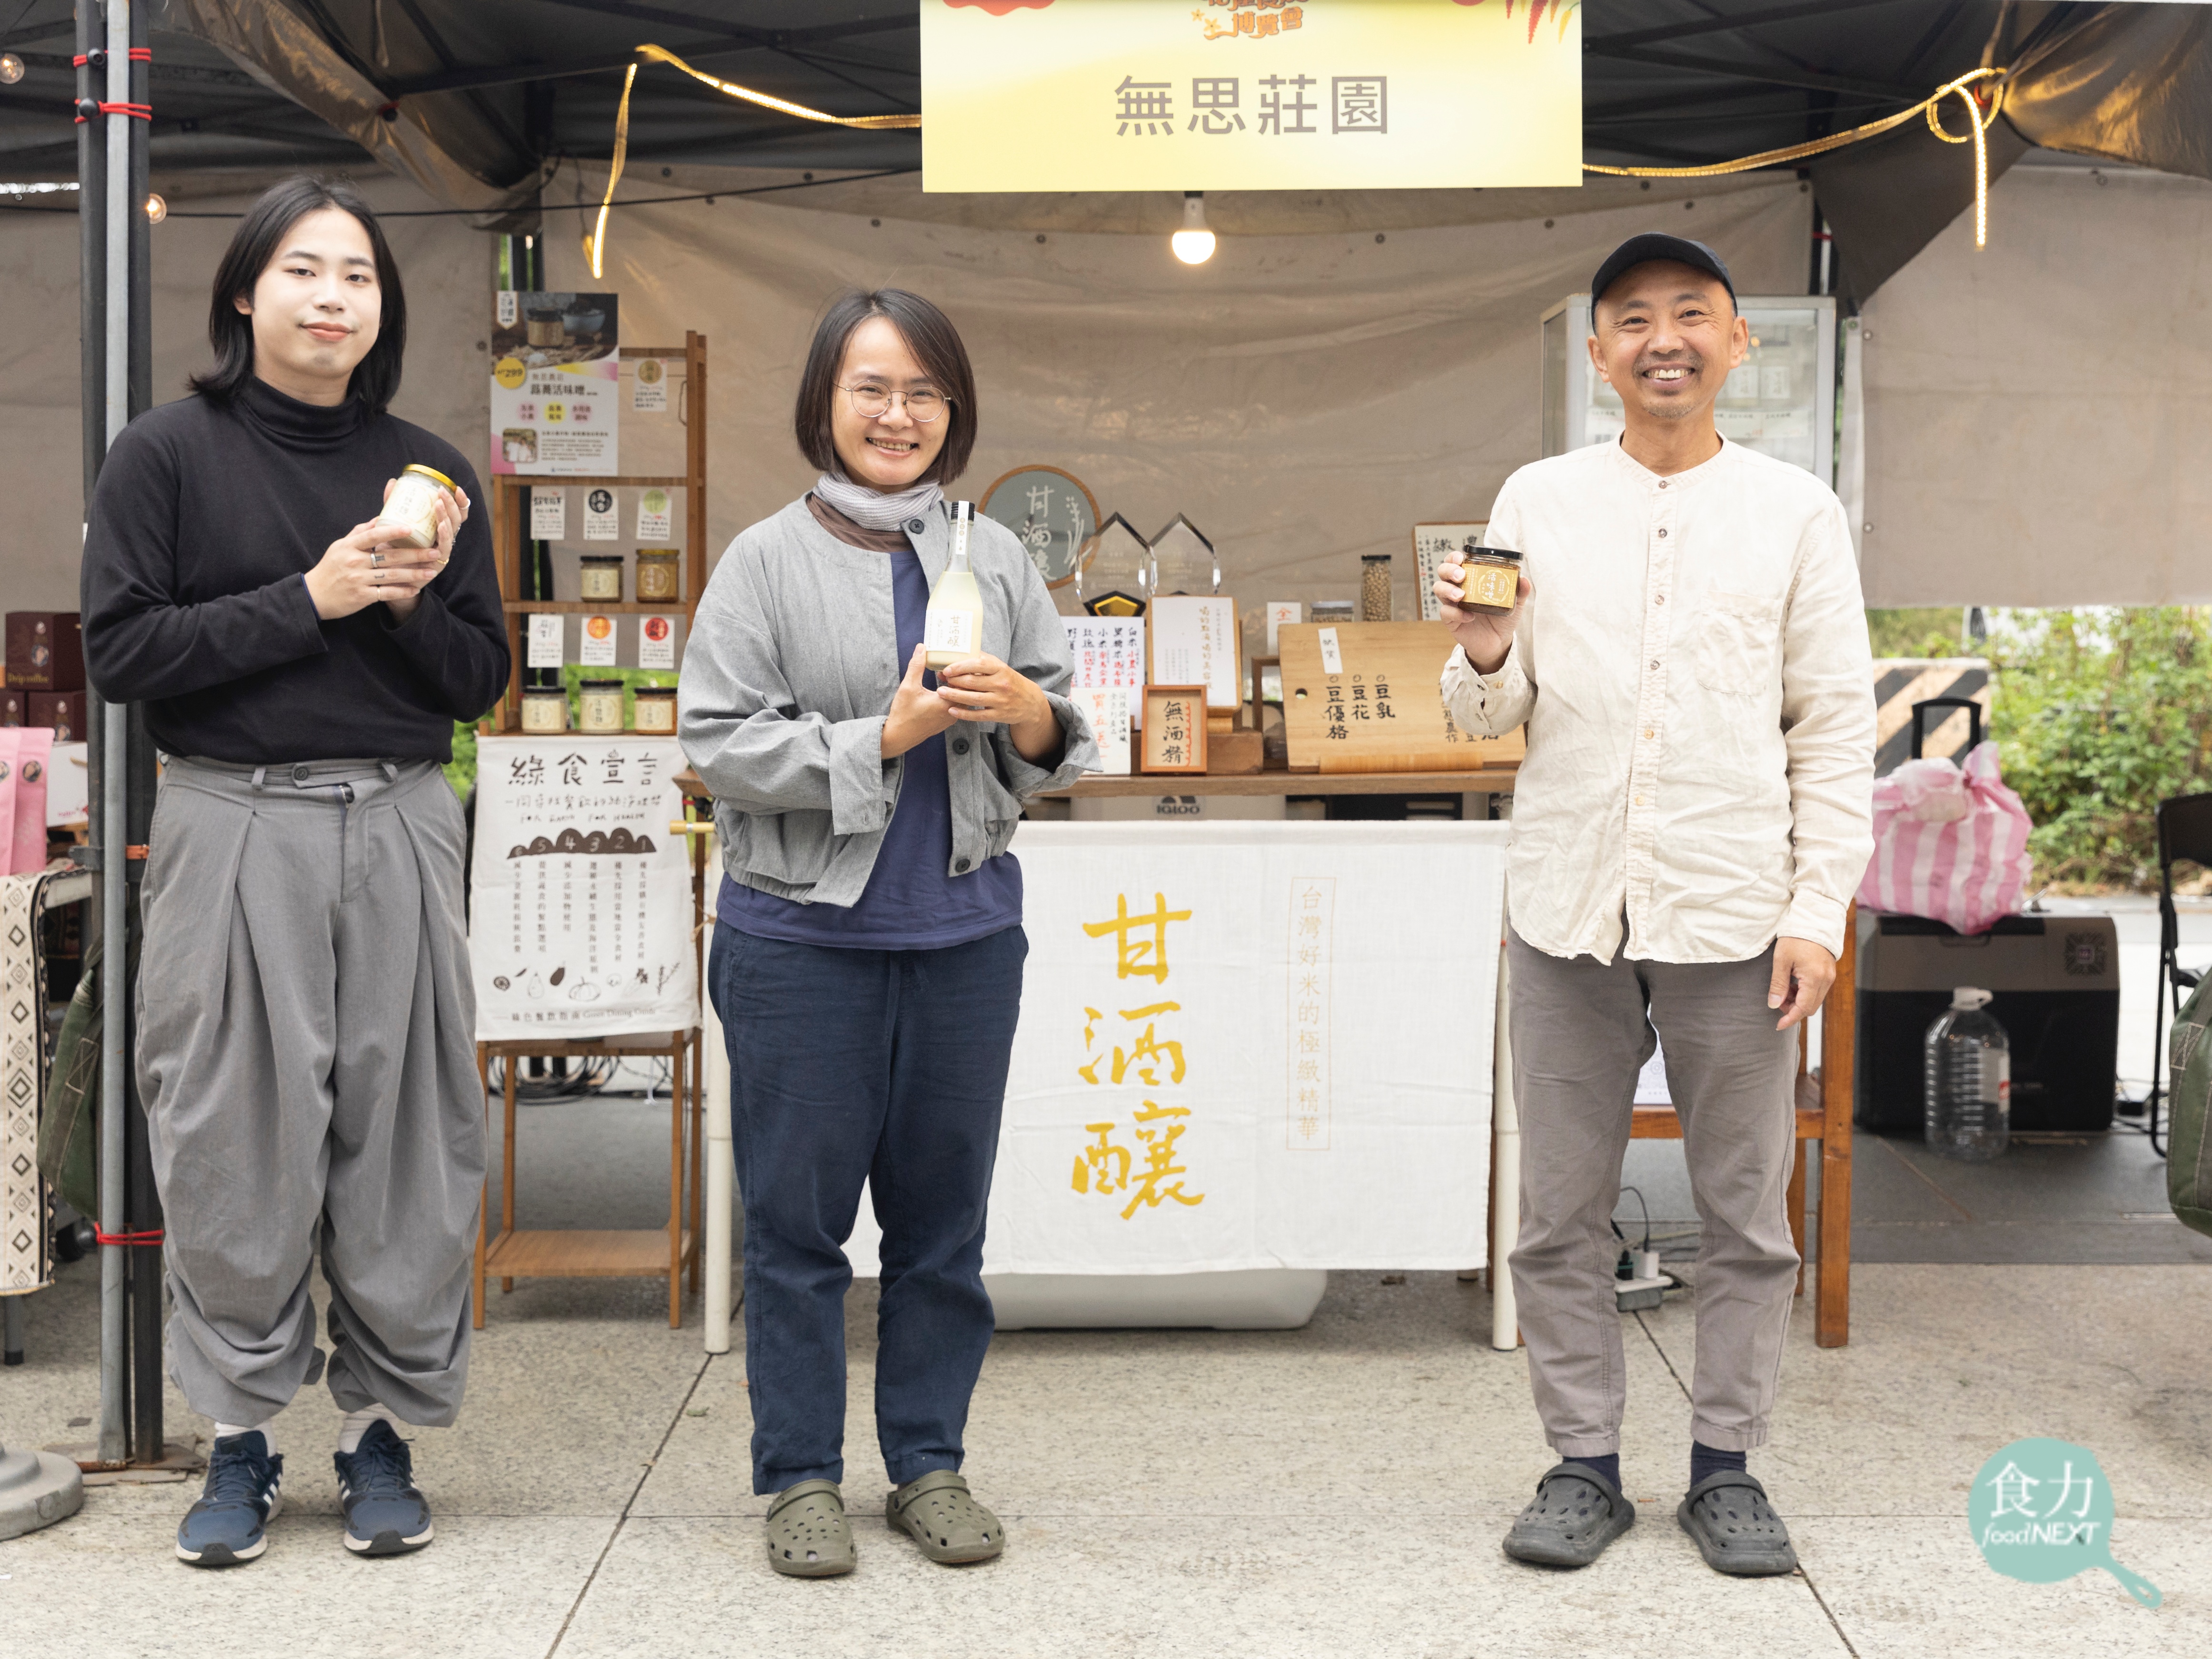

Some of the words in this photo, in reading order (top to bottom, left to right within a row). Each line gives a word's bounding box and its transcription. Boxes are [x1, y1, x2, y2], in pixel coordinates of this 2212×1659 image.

[1113, 74, 1388, 136] 無思莊園
[1485, 573, 1497, 599] 活味噌
[1325, 685, 1349, 740] 豆優格
[1351, 685, 1370, 721] 豆花
[1374, 684, 1396, 719] 豆乳
[1161, 701, 1184, 765] 無酒精
[508, 749, 657, 786] 綠食宣言
[565, 834, 576, 850] 4
[589, 837, 601, 853] 3
[614, 835, 625, 849] 2
[1296, 884, 1323, 1141] 台灣好米的極緻精華
[1071, 892, 1205, 1220] 甘酒釀
